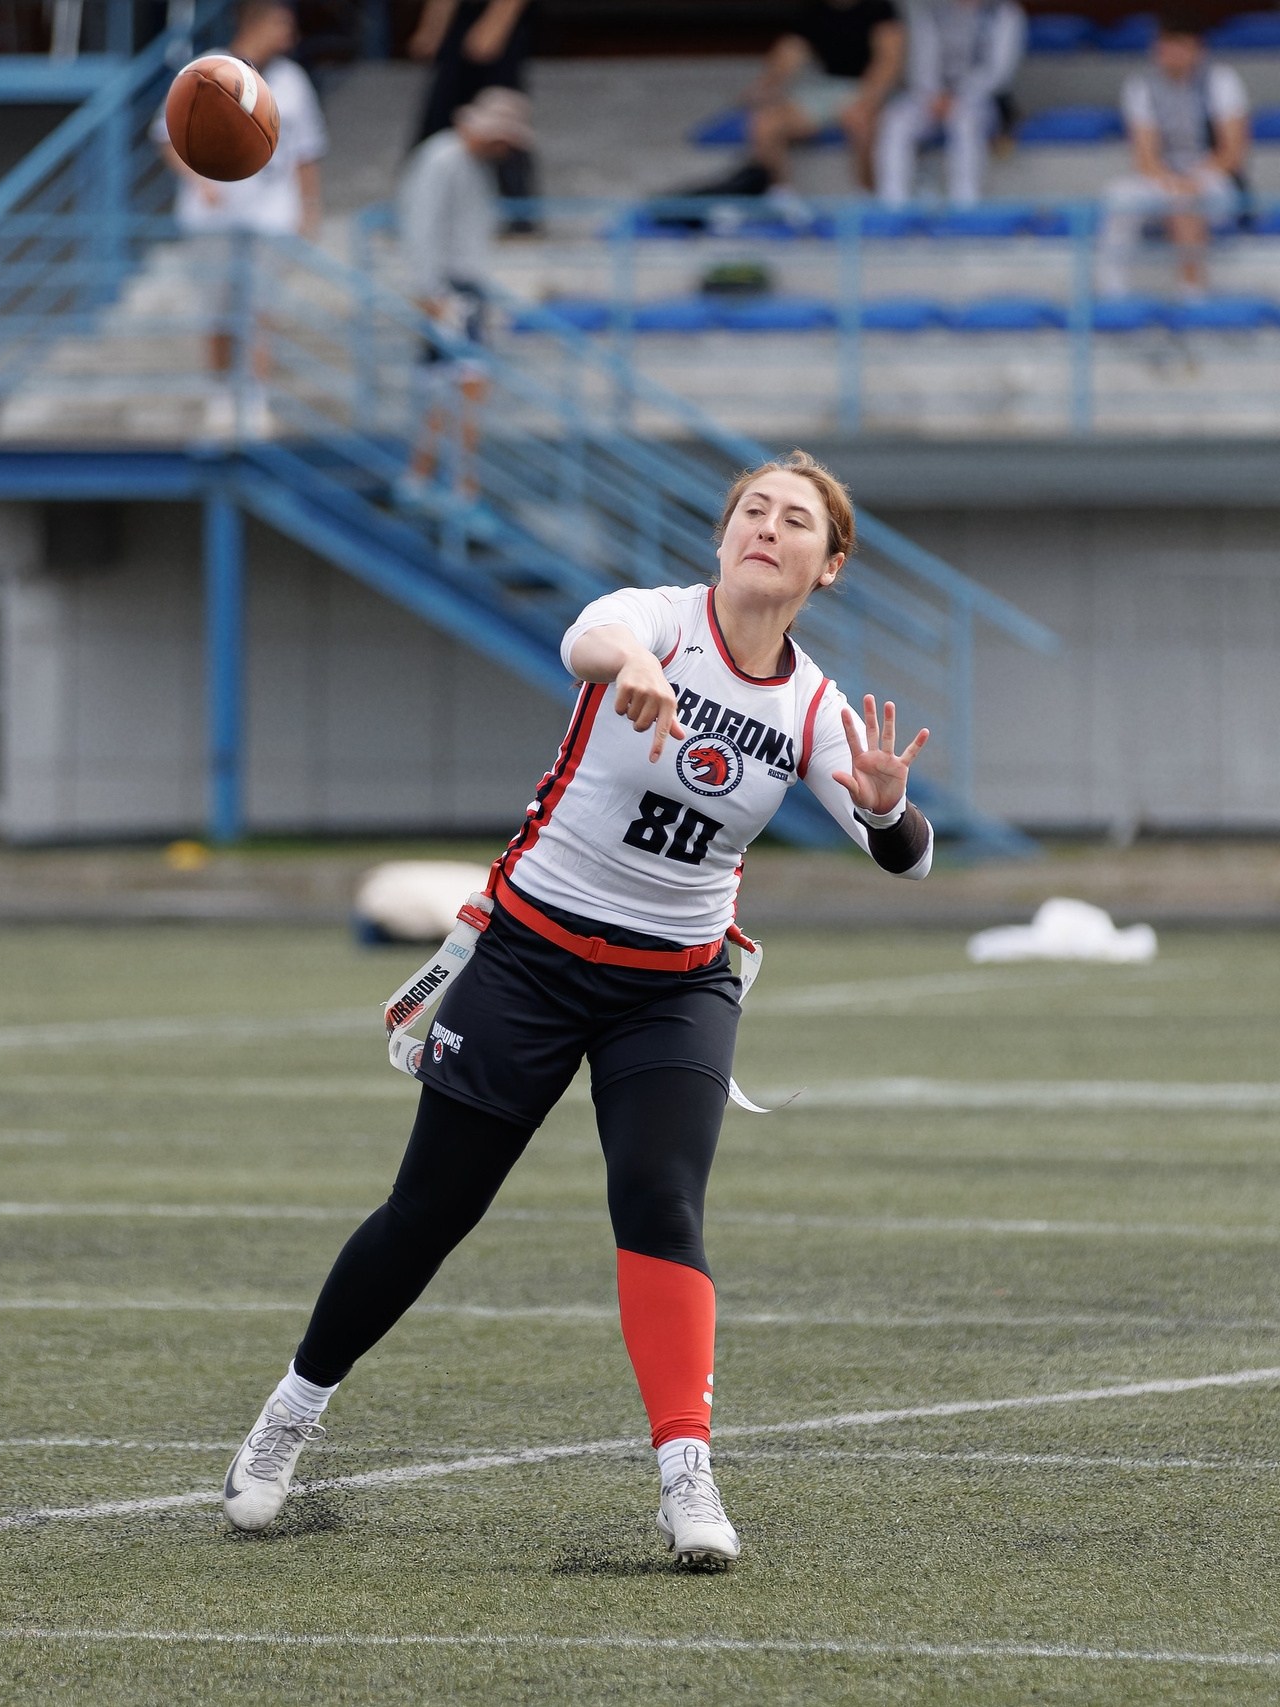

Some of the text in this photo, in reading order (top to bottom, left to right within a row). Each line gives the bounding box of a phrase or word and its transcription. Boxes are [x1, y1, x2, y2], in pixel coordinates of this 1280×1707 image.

[669, 682, 795, 773] RAGONS
[622, 790, 725, 865] 80
[390, 964, 450, 1025] DRAGONS
